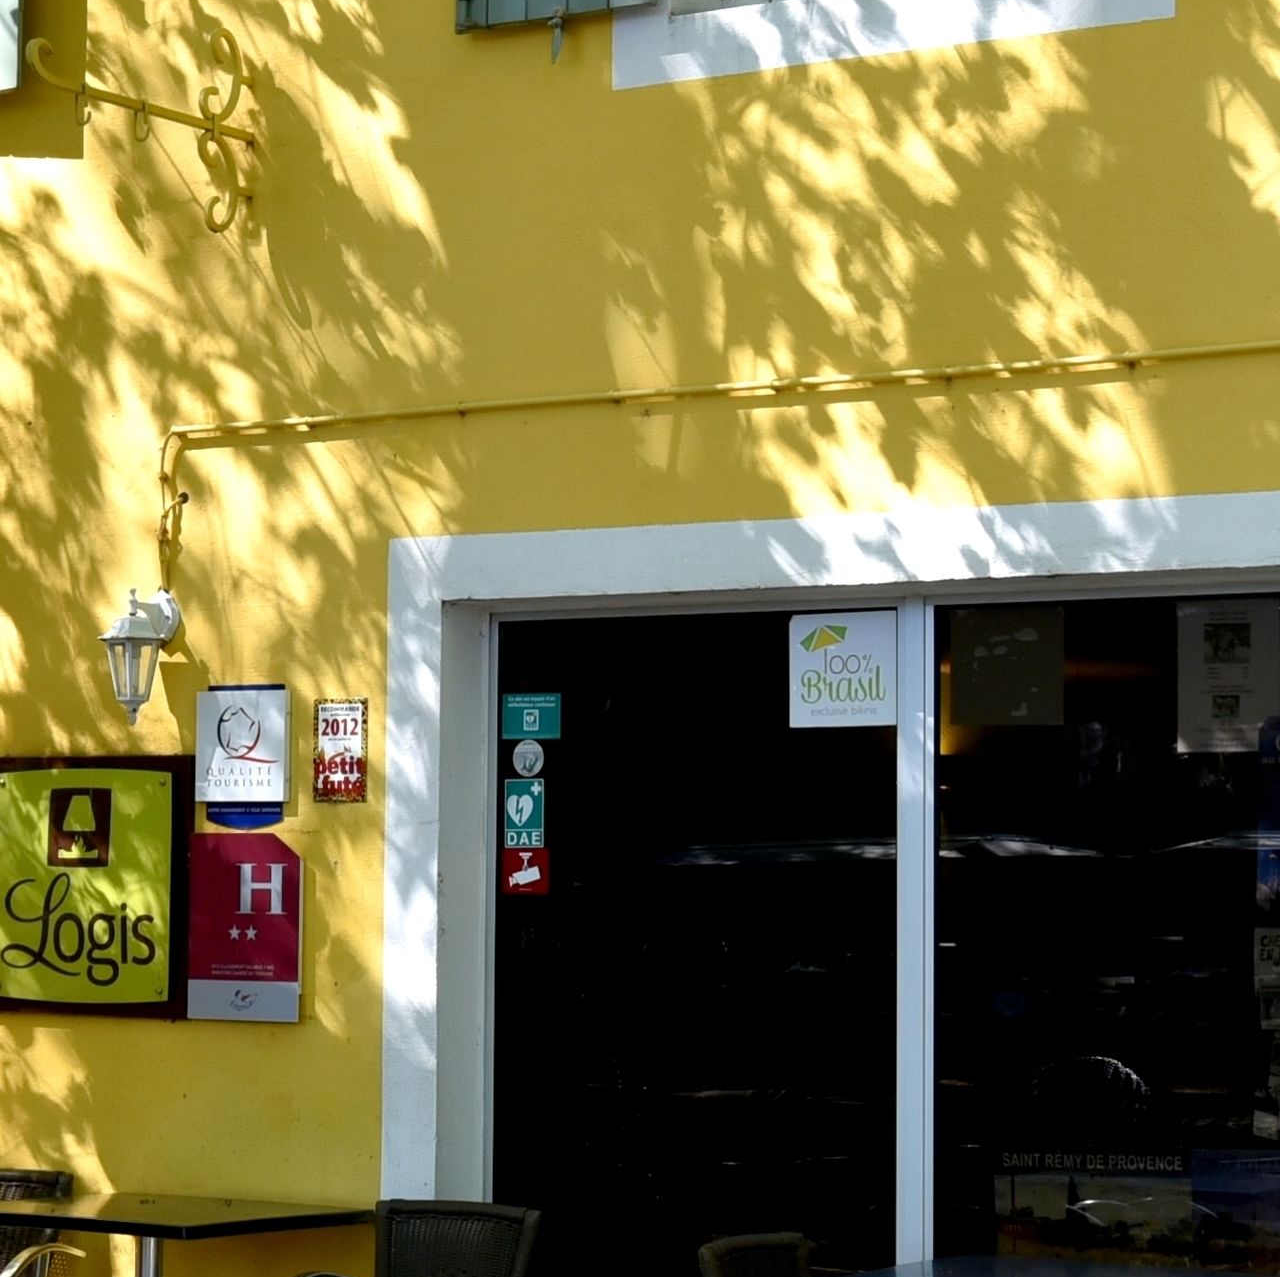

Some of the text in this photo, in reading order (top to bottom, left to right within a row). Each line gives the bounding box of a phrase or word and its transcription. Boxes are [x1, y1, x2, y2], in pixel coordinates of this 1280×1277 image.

[824, 649, 873, 675] 100%
[800, 665, 886, 704] Brasil
[320, 717, 359, 737] 2012
[206, 764, 273, 777] QUALITÉ
[314, 755, 366, 781] petit
[207, 778, 273, 788] TOURISME
[507, 831, 541, 846] DAE
[234, 862, 288, 916] H
[0, 872, 157, 986] Logis
[1002, 1152, 1041, 1168] SAINT
[1045, 1149, 1084, 1169] RÉMY
[1087, 1154, 1105, 1170] DE
[1108, 1155, 1184, 1172] PROVENCE
